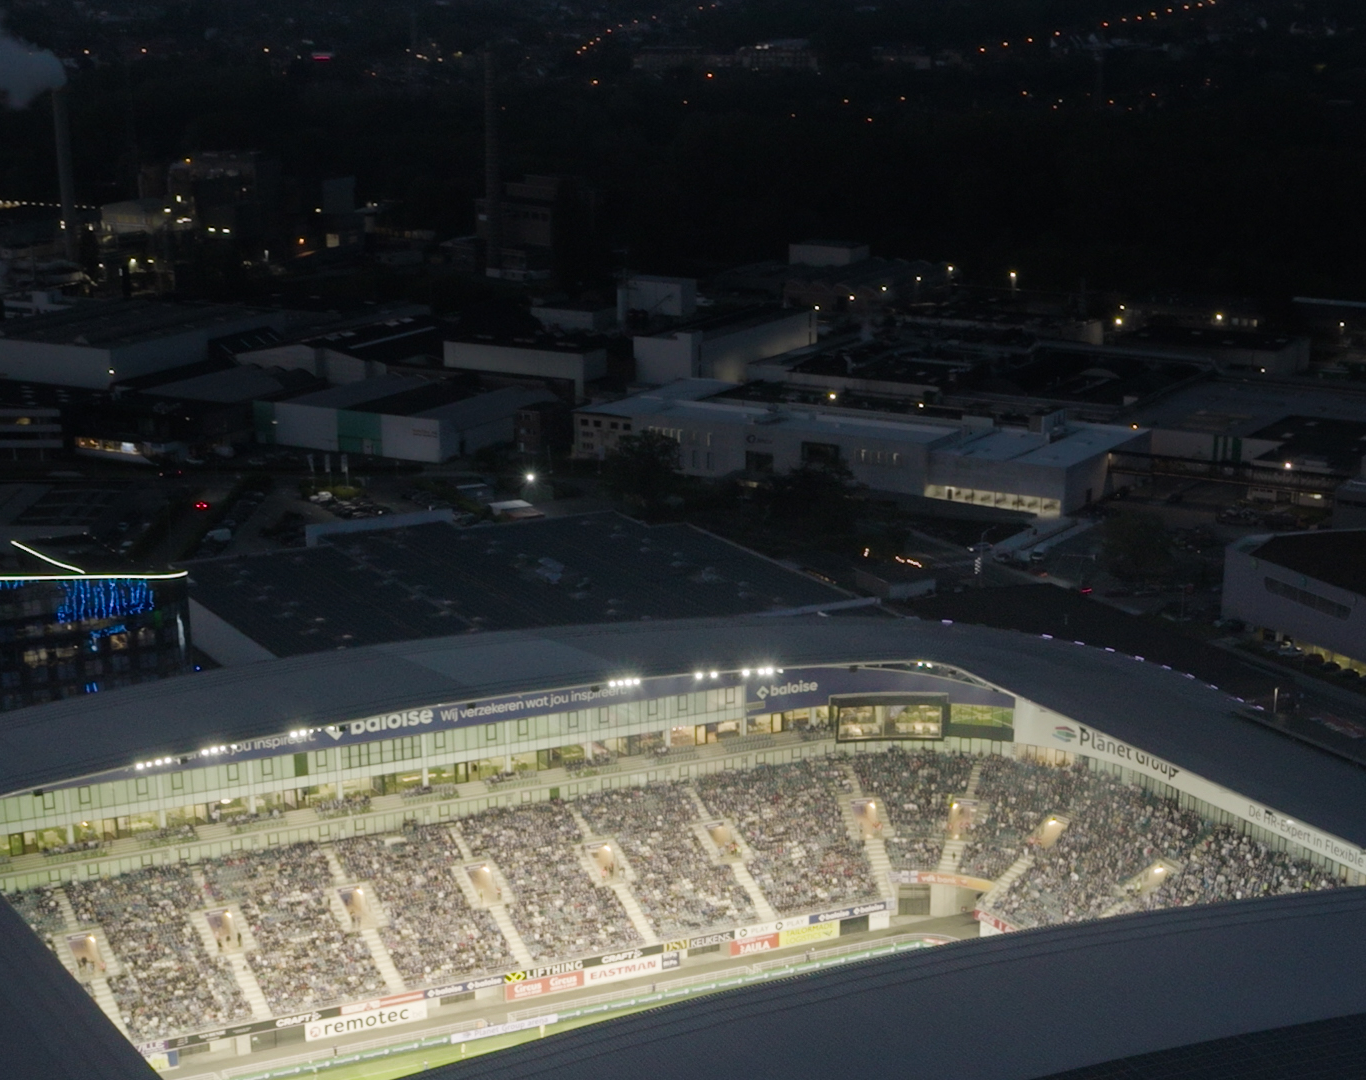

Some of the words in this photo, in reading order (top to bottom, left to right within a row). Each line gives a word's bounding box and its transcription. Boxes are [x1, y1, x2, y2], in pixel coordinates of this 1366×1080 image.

[770, 680, 818, 697] baloise
[440, 707, 459, 723] Wij
[460, 701, 524, 719] verzekeren
[526, 695, 549, 709] wat
[549, 693, 570, 708] jou
[350, 707, 434, 736] baloise
[1080, 729, 1132, 760] Planet
[1248, 805, 1262, 821] Dé
[1263, 811, 1311, 843] HR-Expert
[1313, 835, 1323, 849] in
[1325, 839, 1364, 867] Flexible
[786, 922, 833, 937] TAILORMADE
[786, 932, 821, 944] LOGISTICS
[601, 951, 634, 964] CRAFT
[526, 960, 584, 979] LIFTHING
[590, 960, 657, 980] EASTMAN
[276, 1014, 312, 1028] CRAFT
[324, 1008, 410, 1035] remotec
